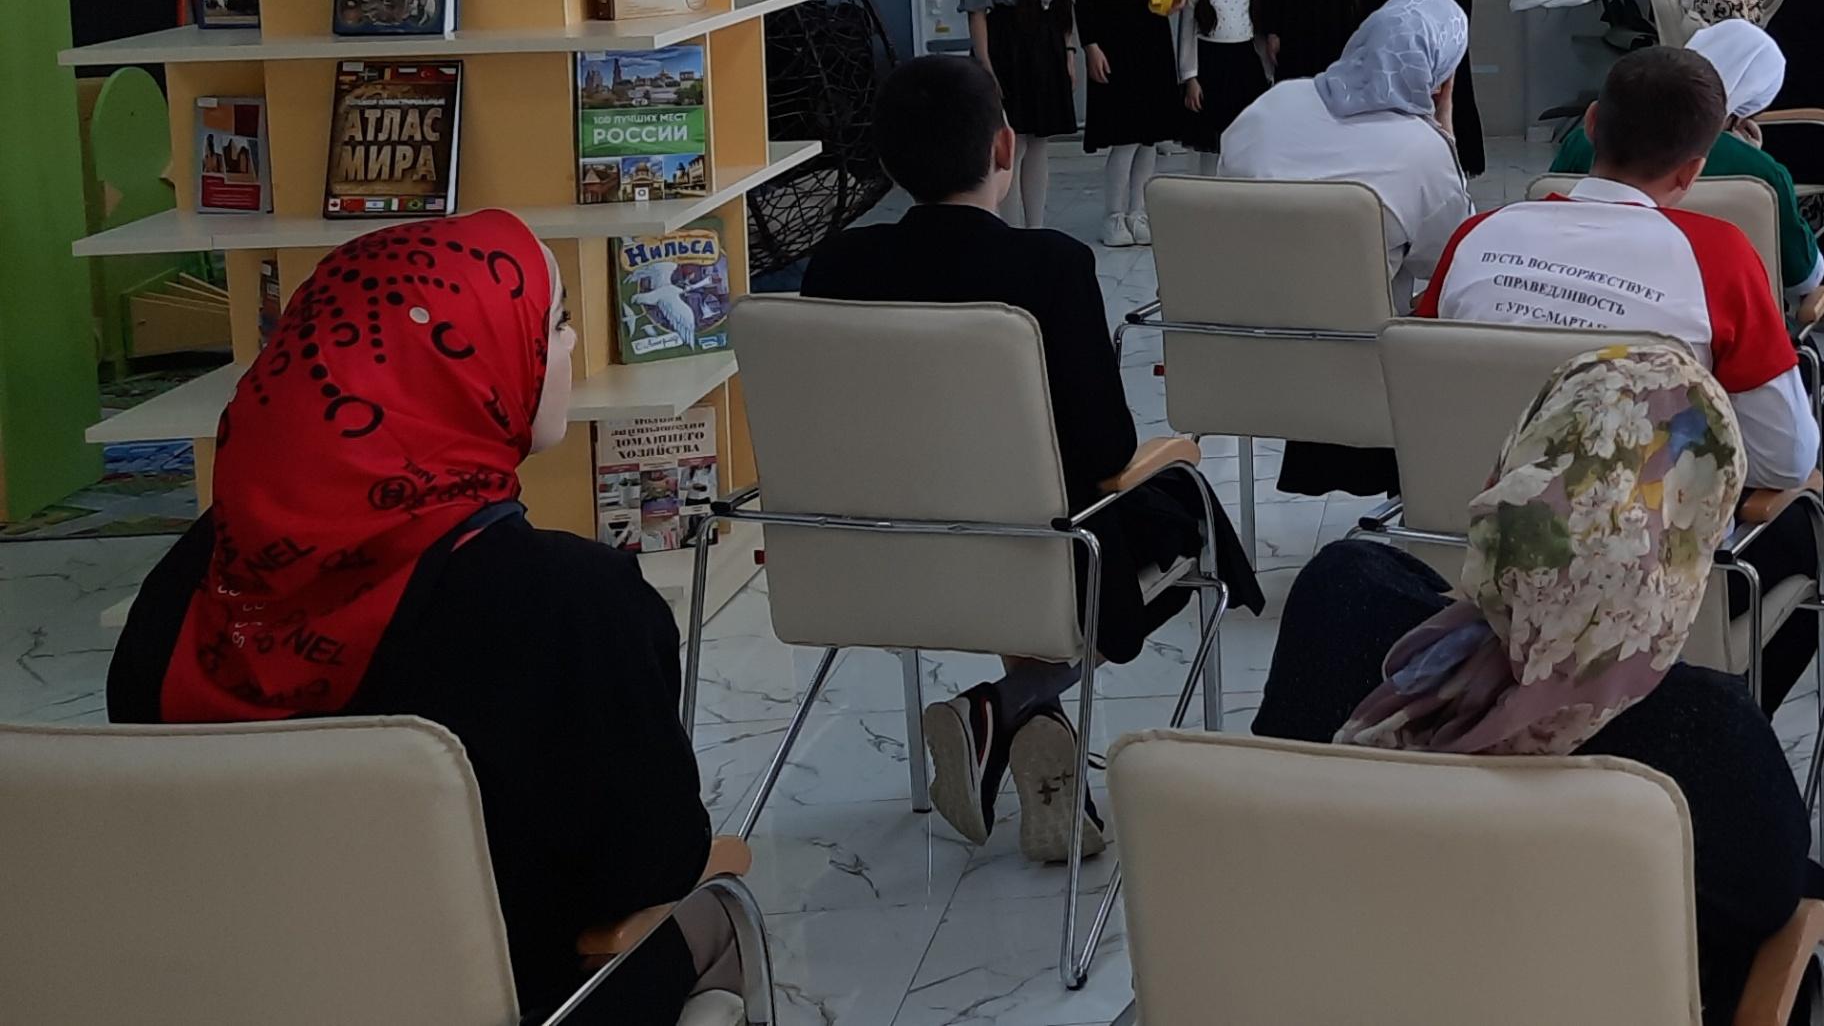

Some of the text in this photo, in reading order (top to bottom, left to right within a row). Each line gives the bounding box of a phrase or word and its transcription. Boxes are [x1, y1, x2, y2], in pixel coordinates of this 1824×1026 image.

[344, 107, 443, 142] АТЛАС
[614, 114, 657, 124] ЛУЧШИХ
[660, 112, 688, 121] МЕСТ
[593, 125, 688, 145] РОССИИ
[339, 145, 437, 181] МИРА
[1481, 251, 1665, 304] ПУСТЬ ВОСТОРЖЕСТВУЕТ
[1493, 274, 1626, 316] СПРАВЕДЛИВОСТЬ
[612, 431, 705, 450] ДОМАШНЕГО
[617, 444, 701, 460] ХОЗЯЙСТВА
